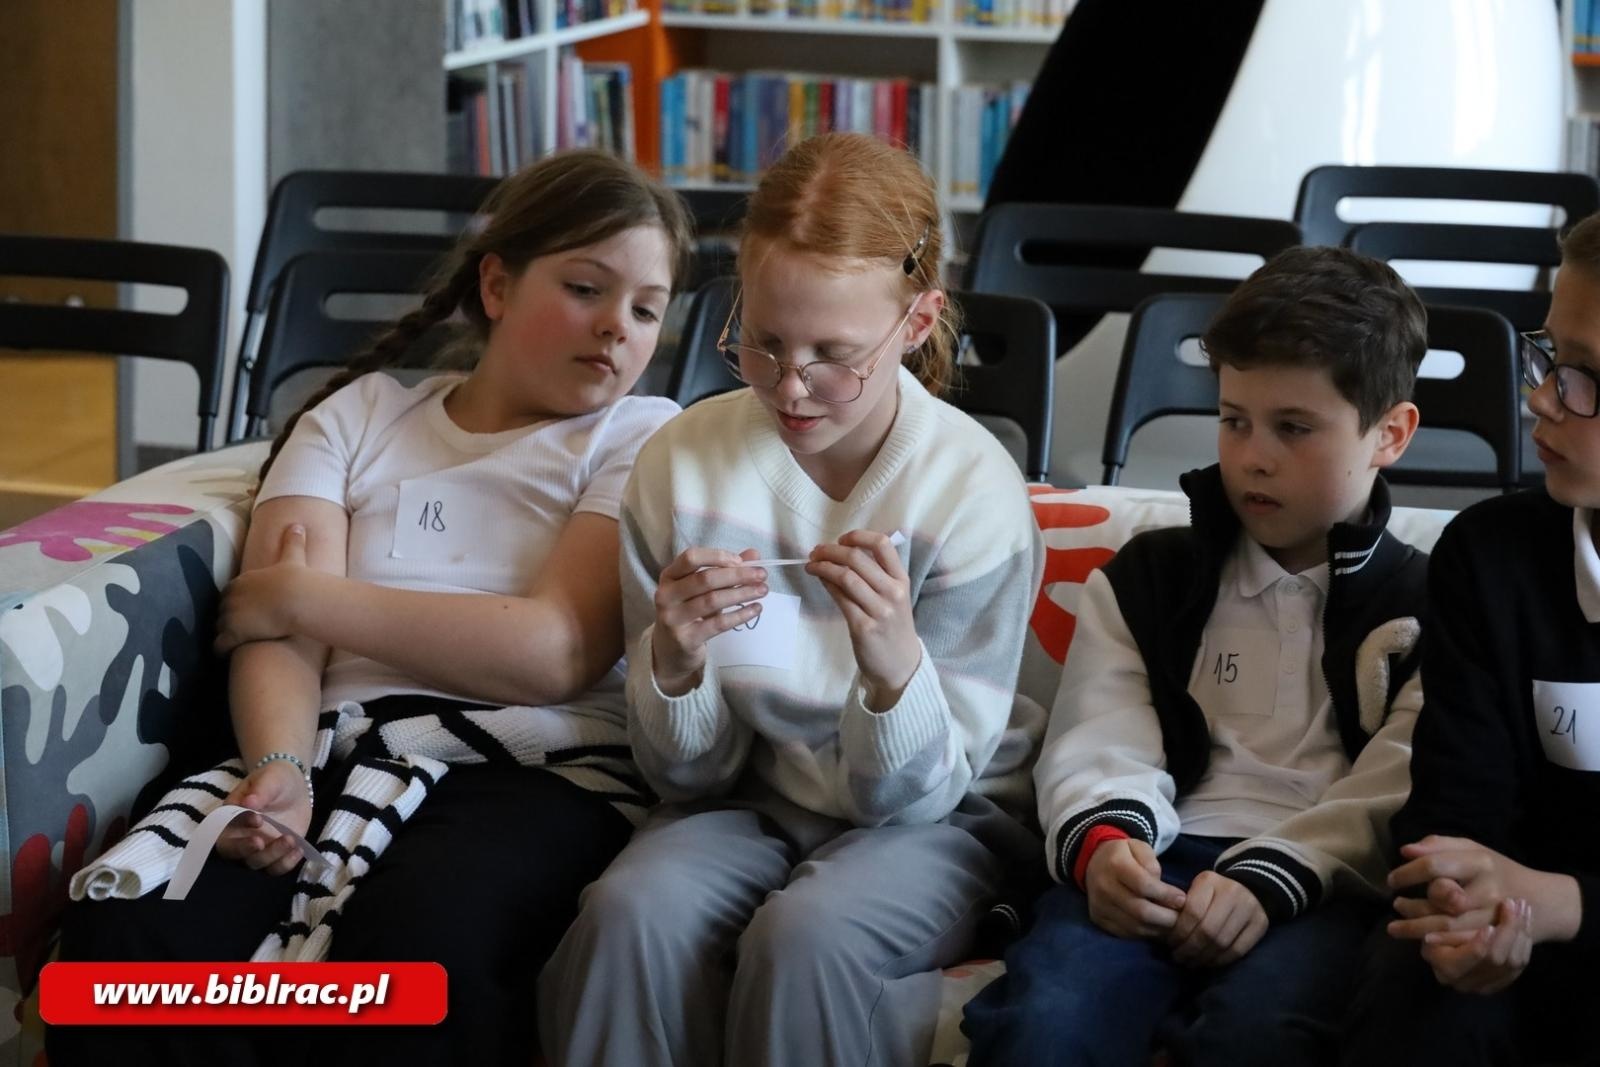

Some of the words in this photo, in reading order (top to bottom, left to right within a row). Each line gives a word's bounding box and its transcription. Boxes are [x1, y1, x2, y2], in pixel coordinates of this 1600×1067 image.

[418, 500, 446, 533] 18
[1213, 652, 1240, 685] 15
[1550, 705, 1577, 745] 21
